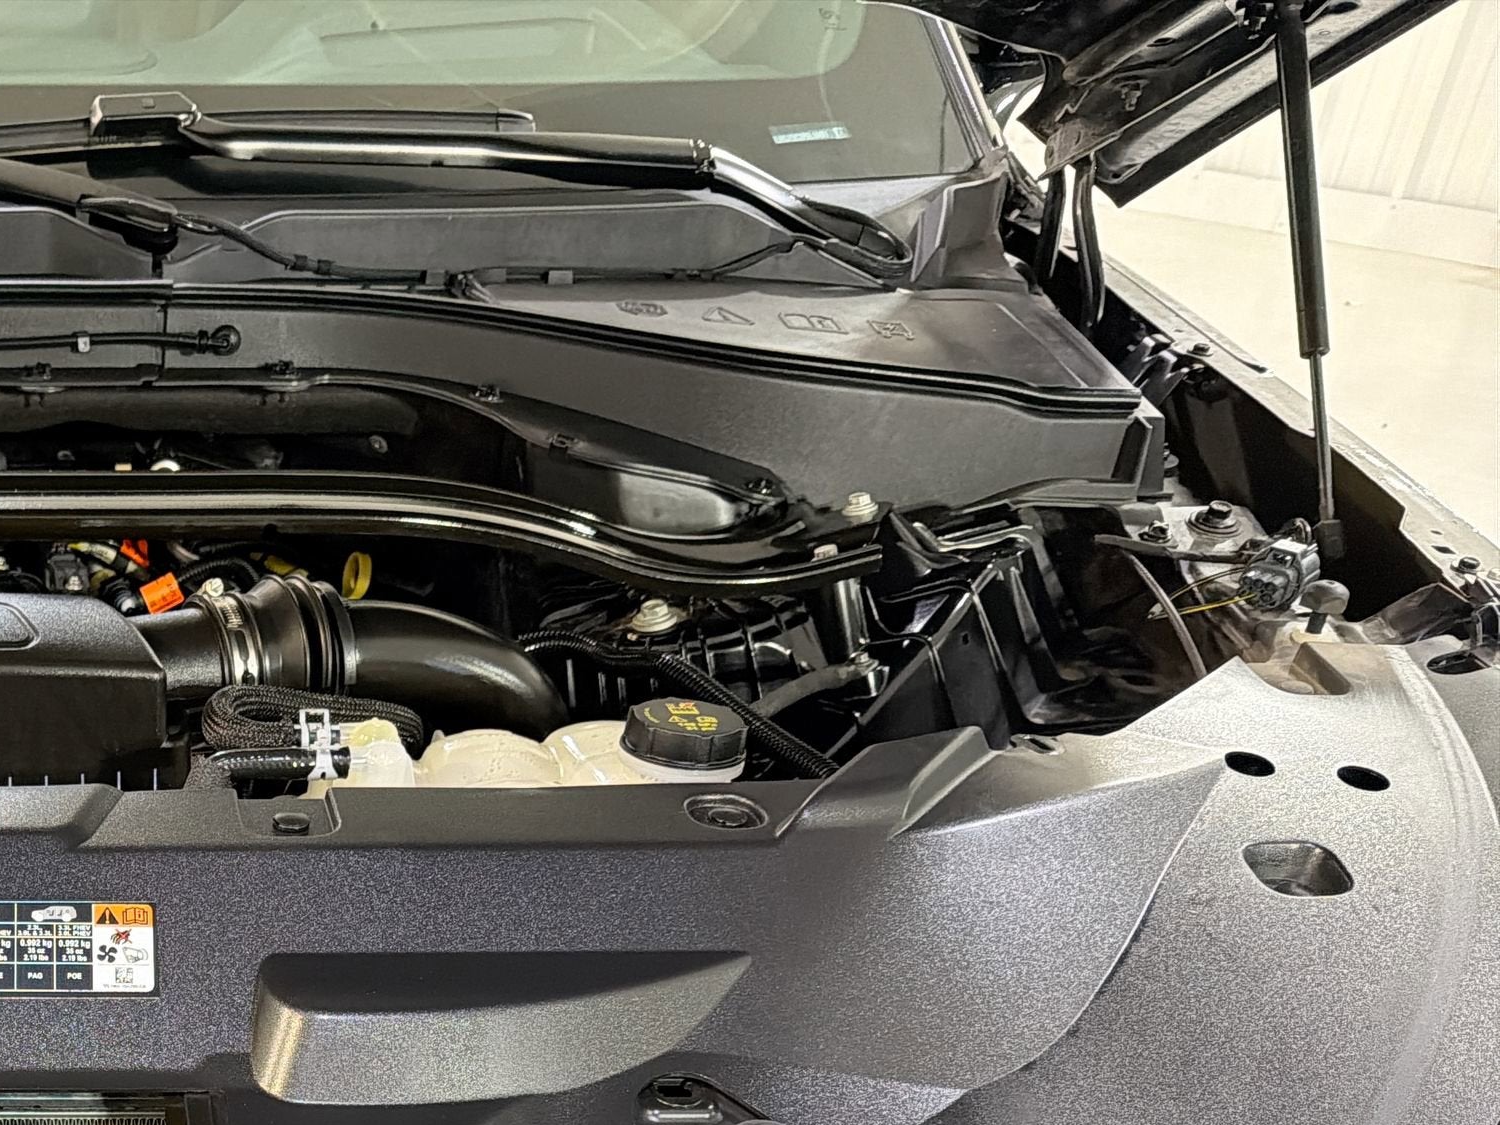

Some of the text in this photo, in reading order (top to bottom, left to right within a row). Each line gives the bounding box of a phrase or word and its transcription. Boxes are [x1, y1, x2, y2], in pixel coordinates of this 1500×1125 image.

[0, 938, 12, 949] kg
[19, 938, 53, 949] 0.992 kg
[58, 938, 91, 950] 0.992 kg
[27, 971, 44, 980] PAG
[66, 972, 83, 980] POE
